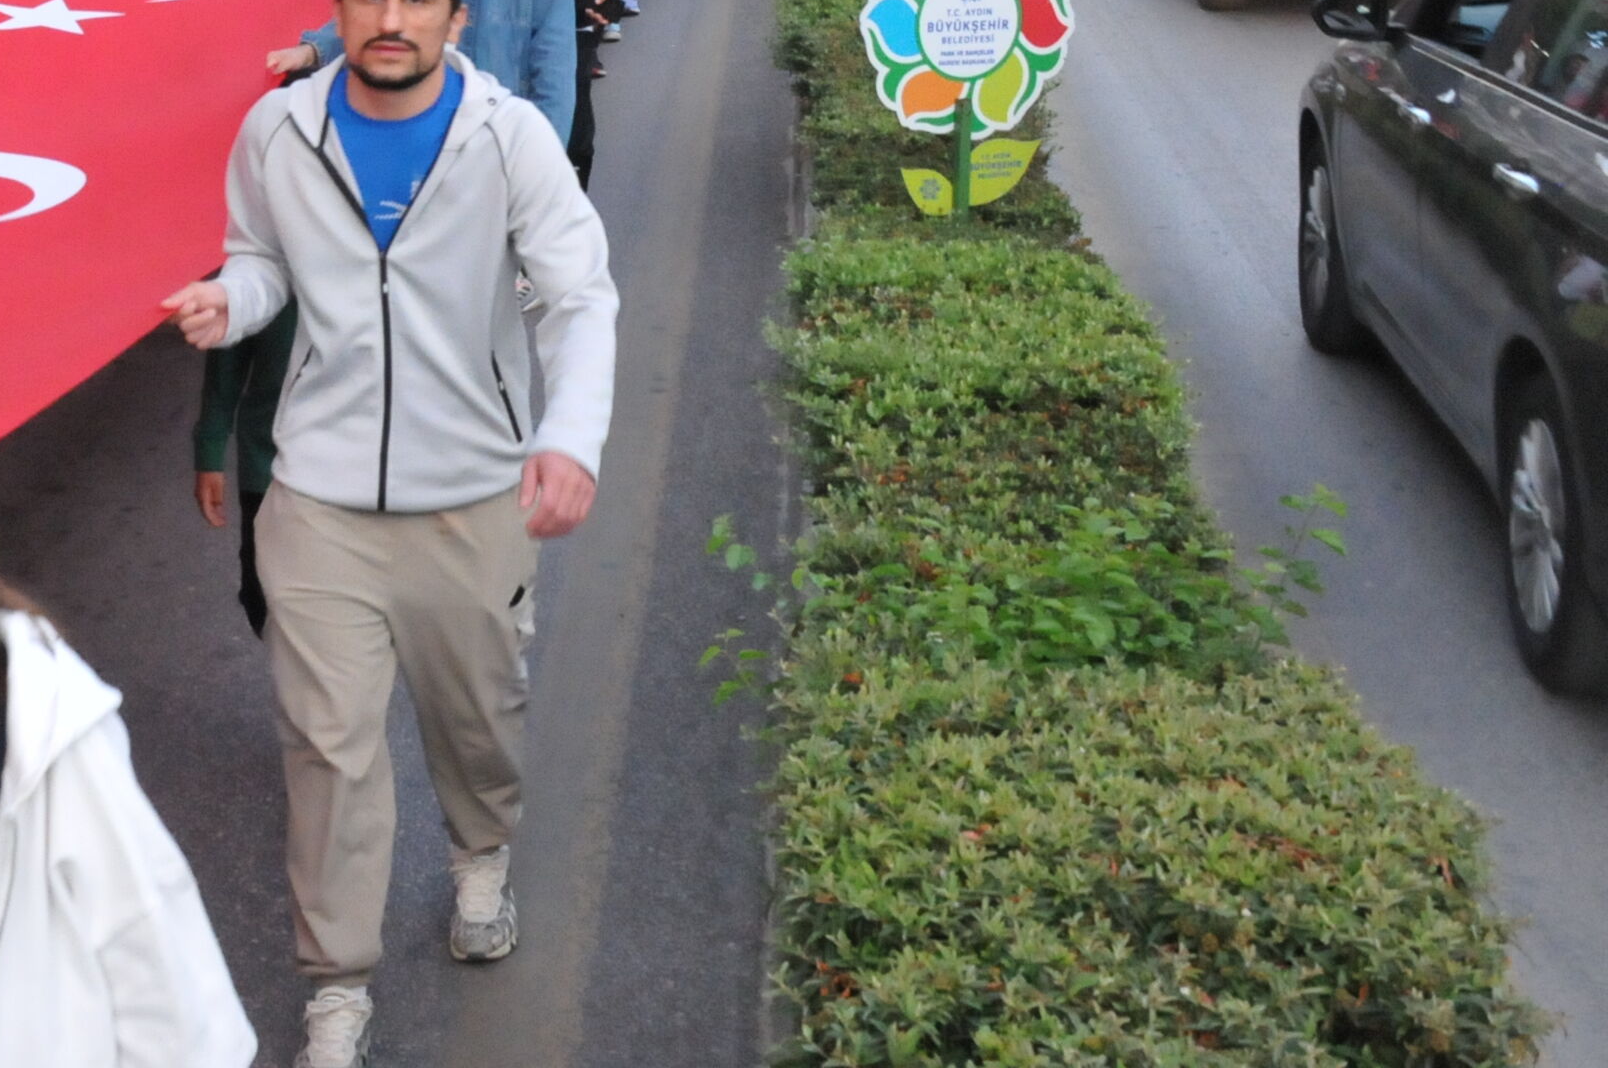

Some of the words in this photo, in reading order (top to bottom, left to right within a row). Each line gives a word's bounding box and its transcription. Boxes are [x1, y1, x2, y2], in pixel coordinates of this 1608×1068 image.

[965, 8, 993, 16] AYDIN
[927, 17, 1009, 33] BÜYÜKŞEHİR
[941, 34, 995, 45] BELEDİYESİ
